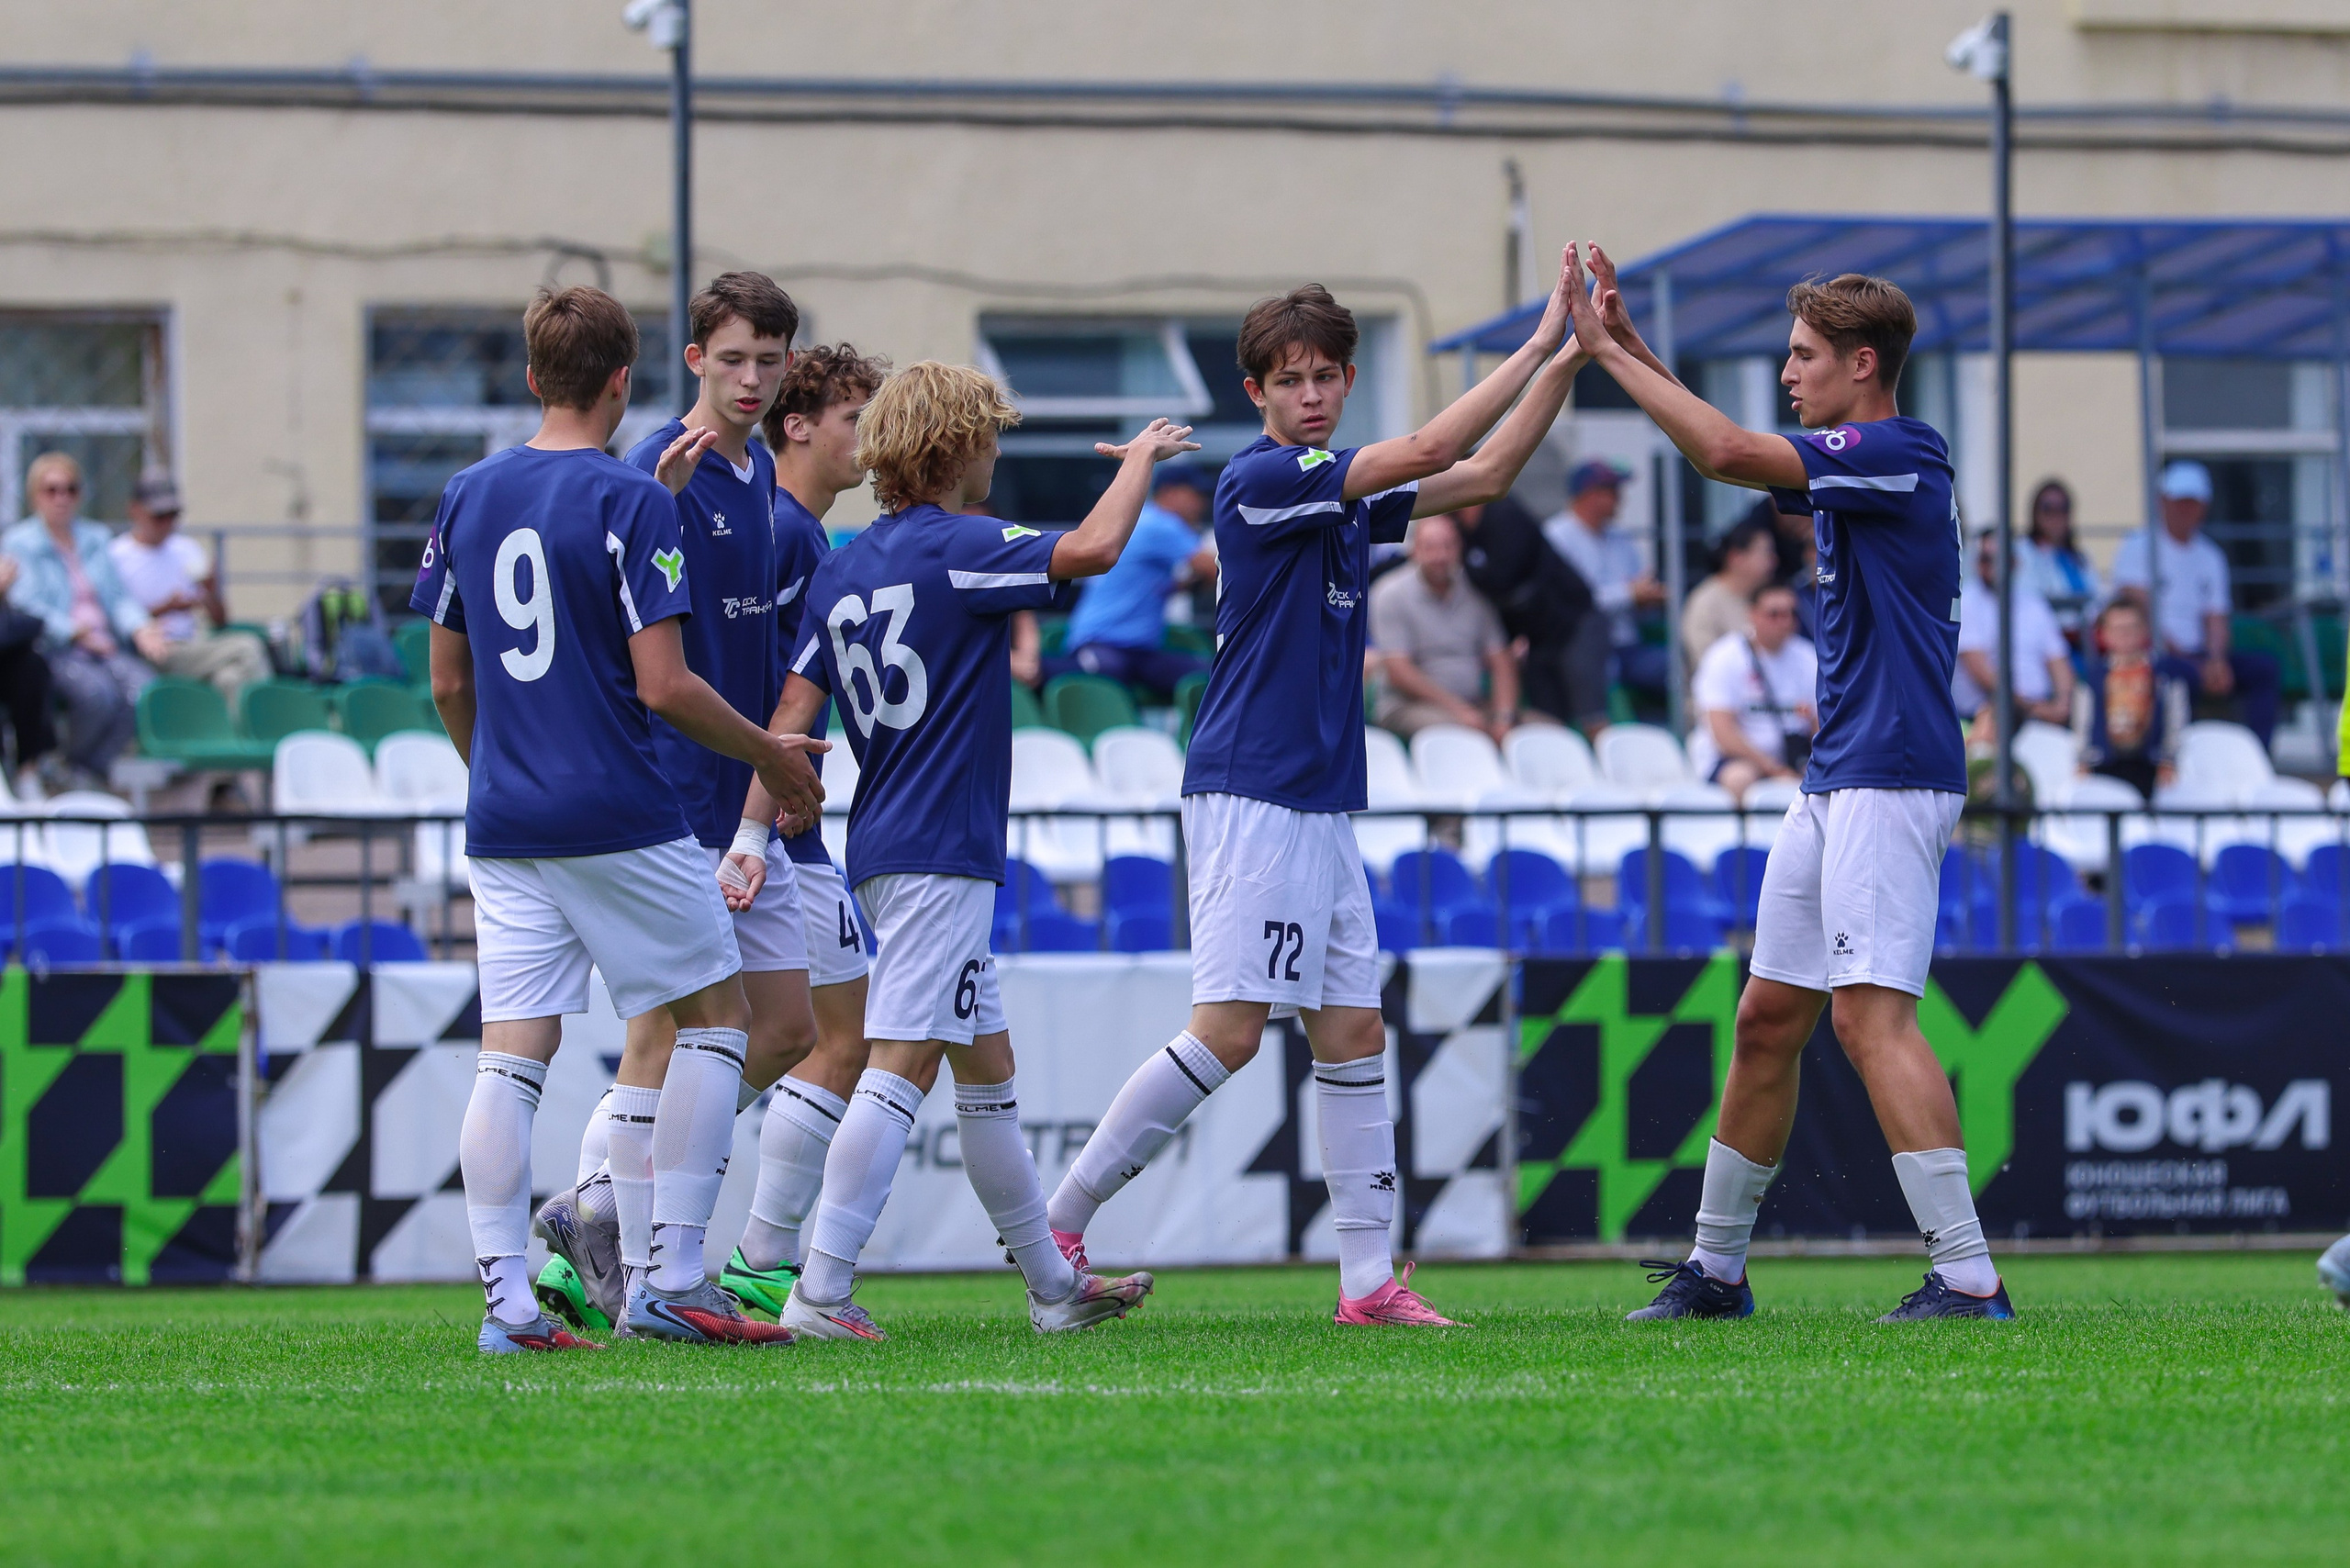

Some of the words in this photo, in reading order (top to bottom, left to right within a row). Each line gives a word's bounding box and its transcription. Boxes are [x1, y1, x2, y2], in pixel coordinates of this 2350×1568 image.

[712, 528, 733, 537] KELME
[493, 528, 555, 682] 9
[826, 582, 928, 740] 63
[837, 899, 860, 954] 4
[1263, 920, 1304, 981] 72
[2065, 1076, 2333, 1154] ЮФЛ
[639, 1290, 646, 1300] 9
